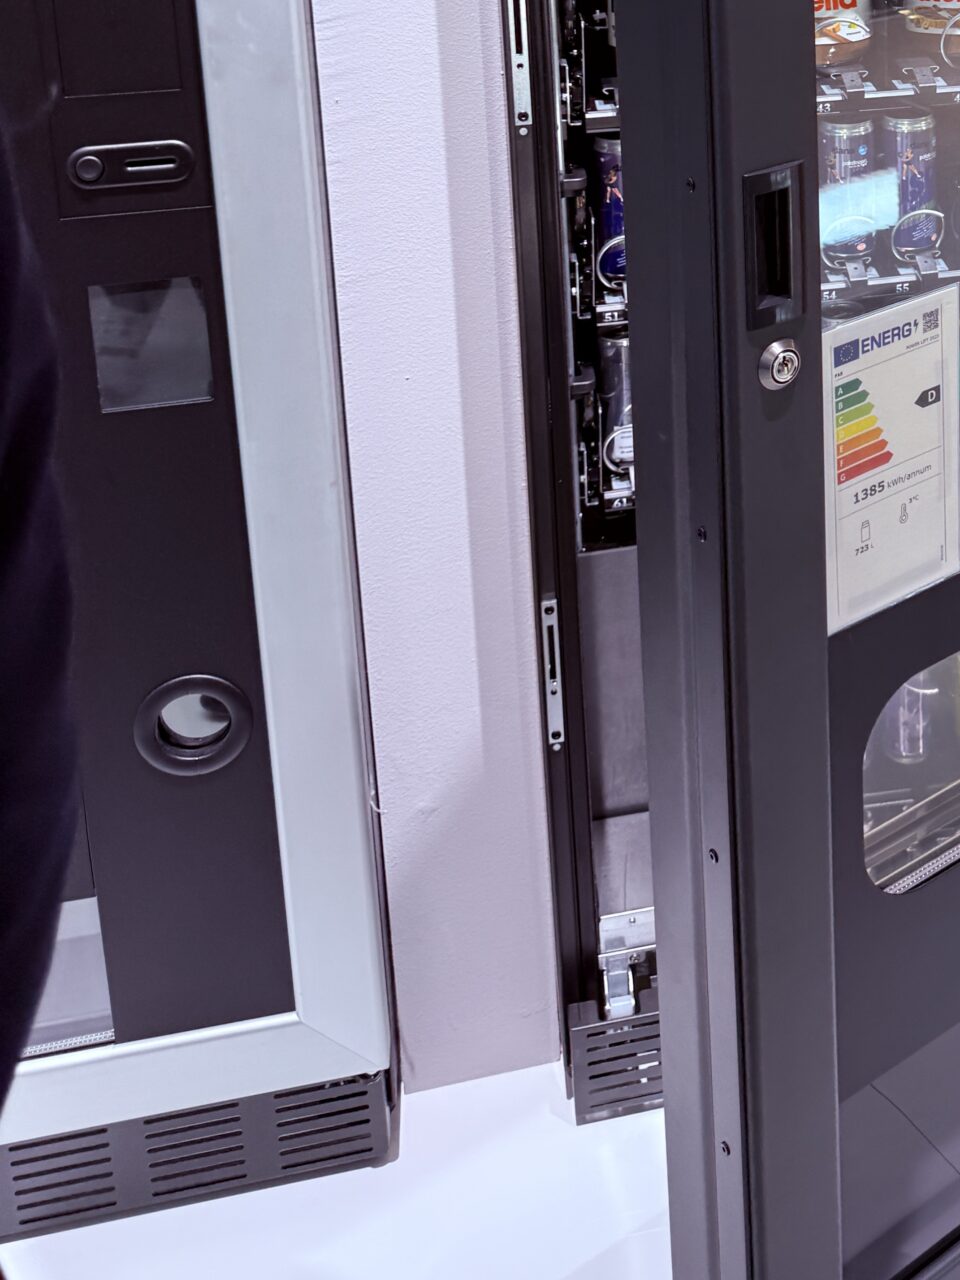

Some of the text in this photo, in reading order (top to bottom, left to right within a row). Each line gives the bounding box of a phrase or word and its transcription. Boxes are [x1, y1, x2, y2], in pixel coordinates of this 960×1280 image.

[816, 102, 831, 114] 43
[896, 283, 910, 293] 55
[823, 291, 837, 300] 54
[604, 312, 618, 322] 51
[861, 322, 912, 355] ENERG
[838, 387, 844, 395] A
[927, 390, 936, 402] D
[838, 402, 843, 410] B
[838, 416, 843, 424] C
[839, 445, 843, 453] E
[853, 464, 932, 504] 1385 kWh/annum
[613, 497, 628, 508] 61
[855, 544, 869, 556] 723
